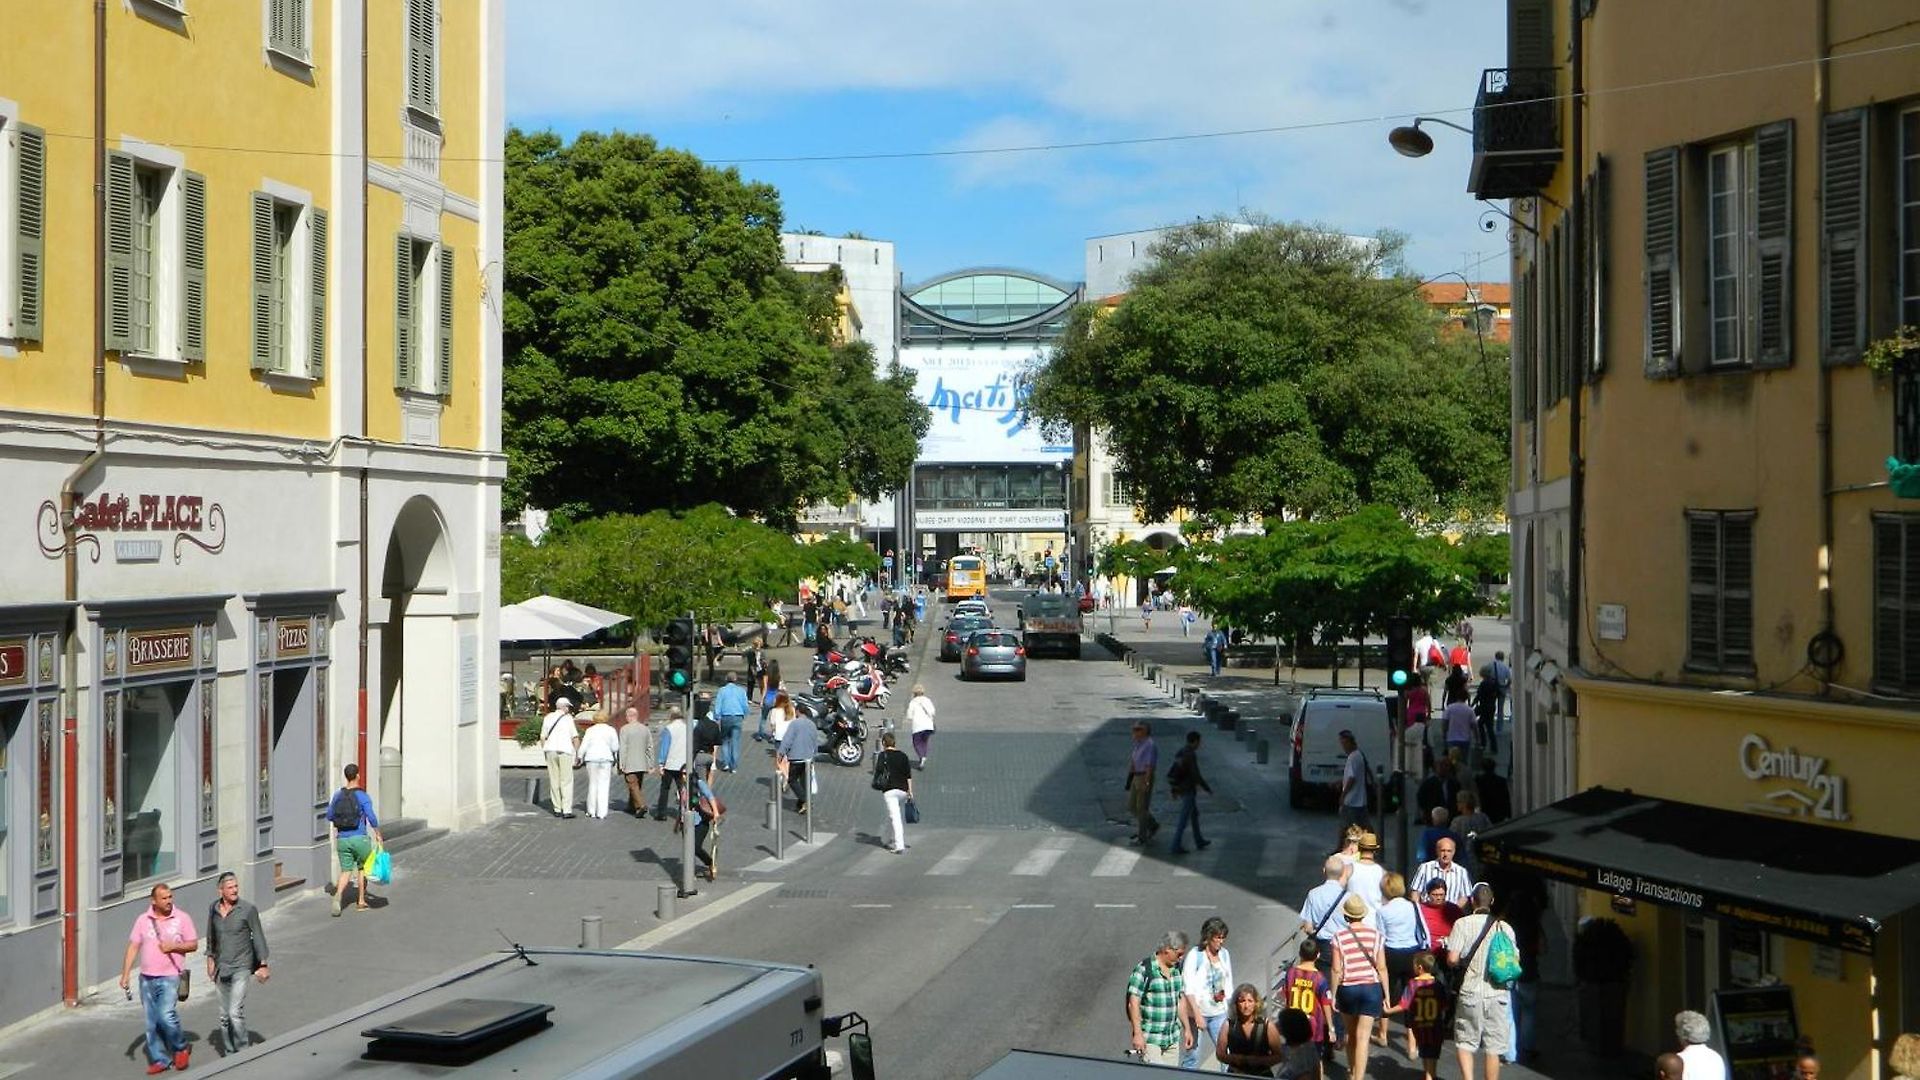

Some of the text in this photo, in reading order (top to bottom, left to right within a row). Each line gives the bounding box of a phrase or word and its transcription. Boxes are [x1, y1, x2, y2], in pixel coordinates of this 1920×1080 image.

[138, 495, 203, 531] PLACE
[129, 637, 190, 665] BRASSERIE
[278, 627, 307, 650] PIZZAS
[1740, 733, 1824, 788] Century
[1635, 877, 1704, 908] Transactions
[1294, 978, 1313, 988] MESSI
[1290, 987, 1315, 1013] 10
[1414, 997, 1438, 1021] 10
